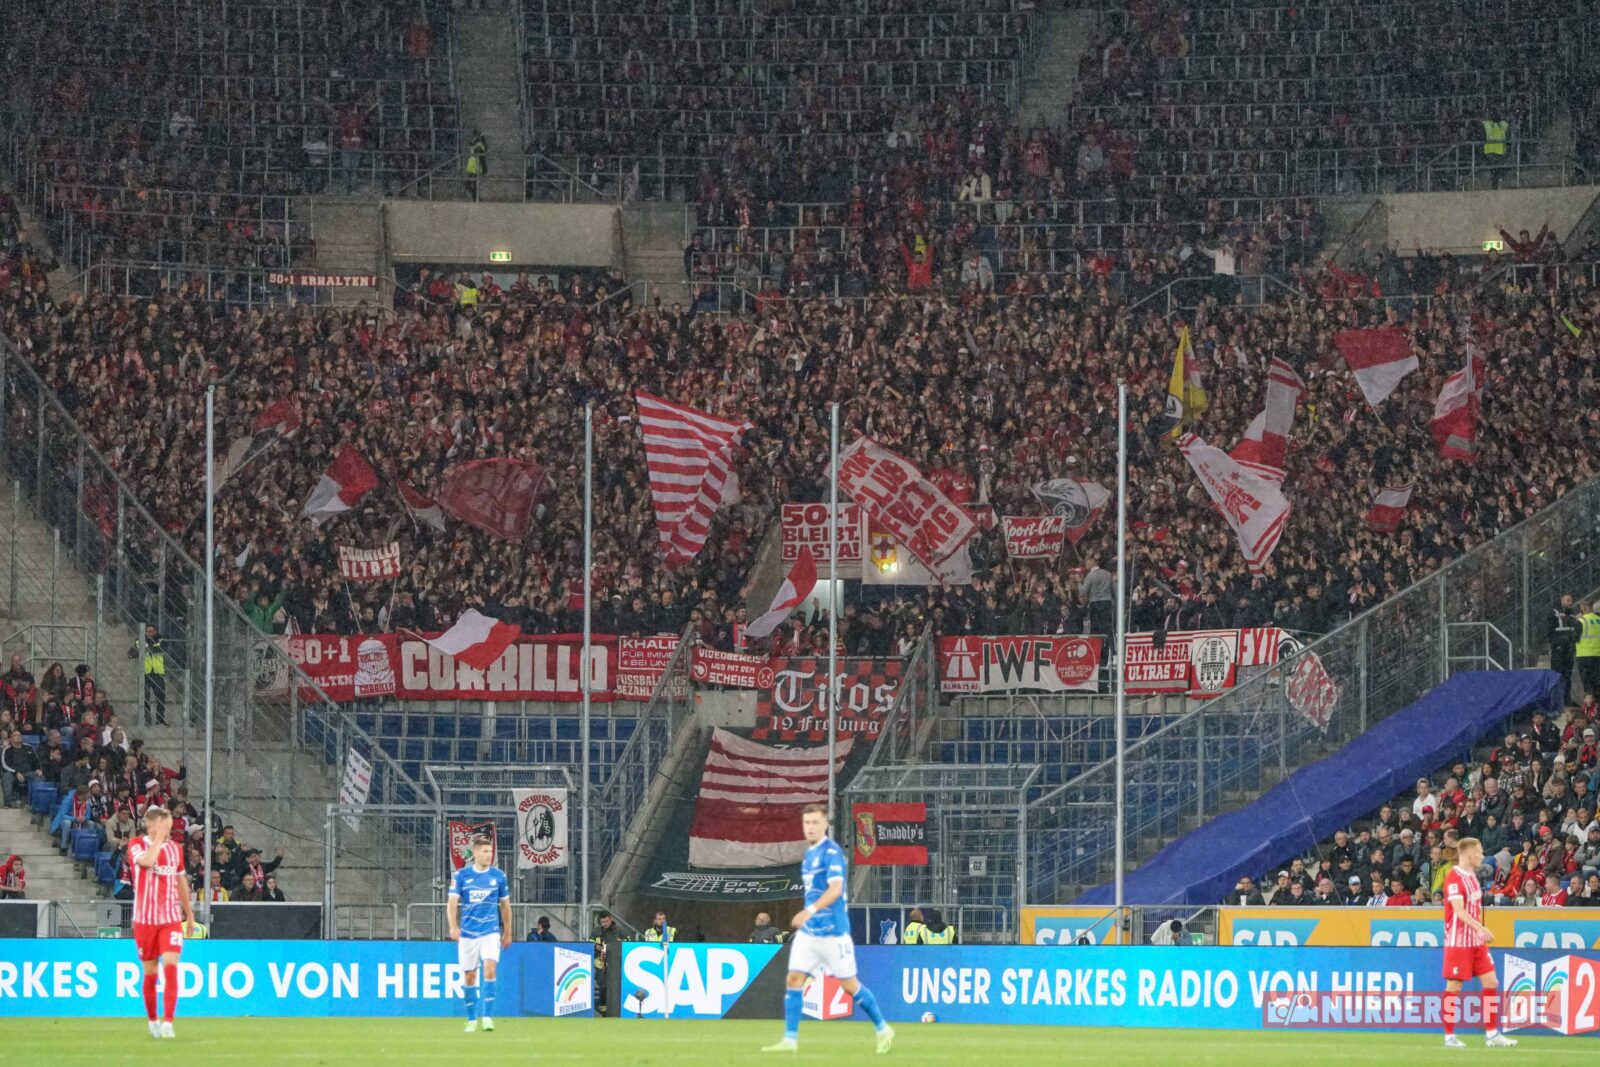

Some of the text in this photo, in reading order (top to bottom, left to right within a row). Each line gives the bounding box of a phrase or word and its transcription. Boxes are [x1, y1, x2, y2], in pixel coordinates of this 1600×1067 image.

[269, 273, 295, 285] 50+1
[288, 638, 351, 665] 50+1
[401, 641, 607, 692] CORRILLO
[983, 639, 1053, 685] IWF
[709, 672, 755, 688] SCHEISS
[727, 664, 739, 672] MIT
[740, 666, 755, 674] DEM
[1128, 664, 1186, 681] ULTRAS 79
[518, 794, 562, 813] FREIBURGER
[268, 962, 359, 998] VON
[623, 946, 750, 1014] SAP
[902, 967, 991, 1004] UNSER
[1001, 968, 1127, 1006] STARKES
[1138, 970, 1239, 1008] RADIO
[1248, 970, 1318, 1009] VON
[1575, 961, 1596, 1030] 2
